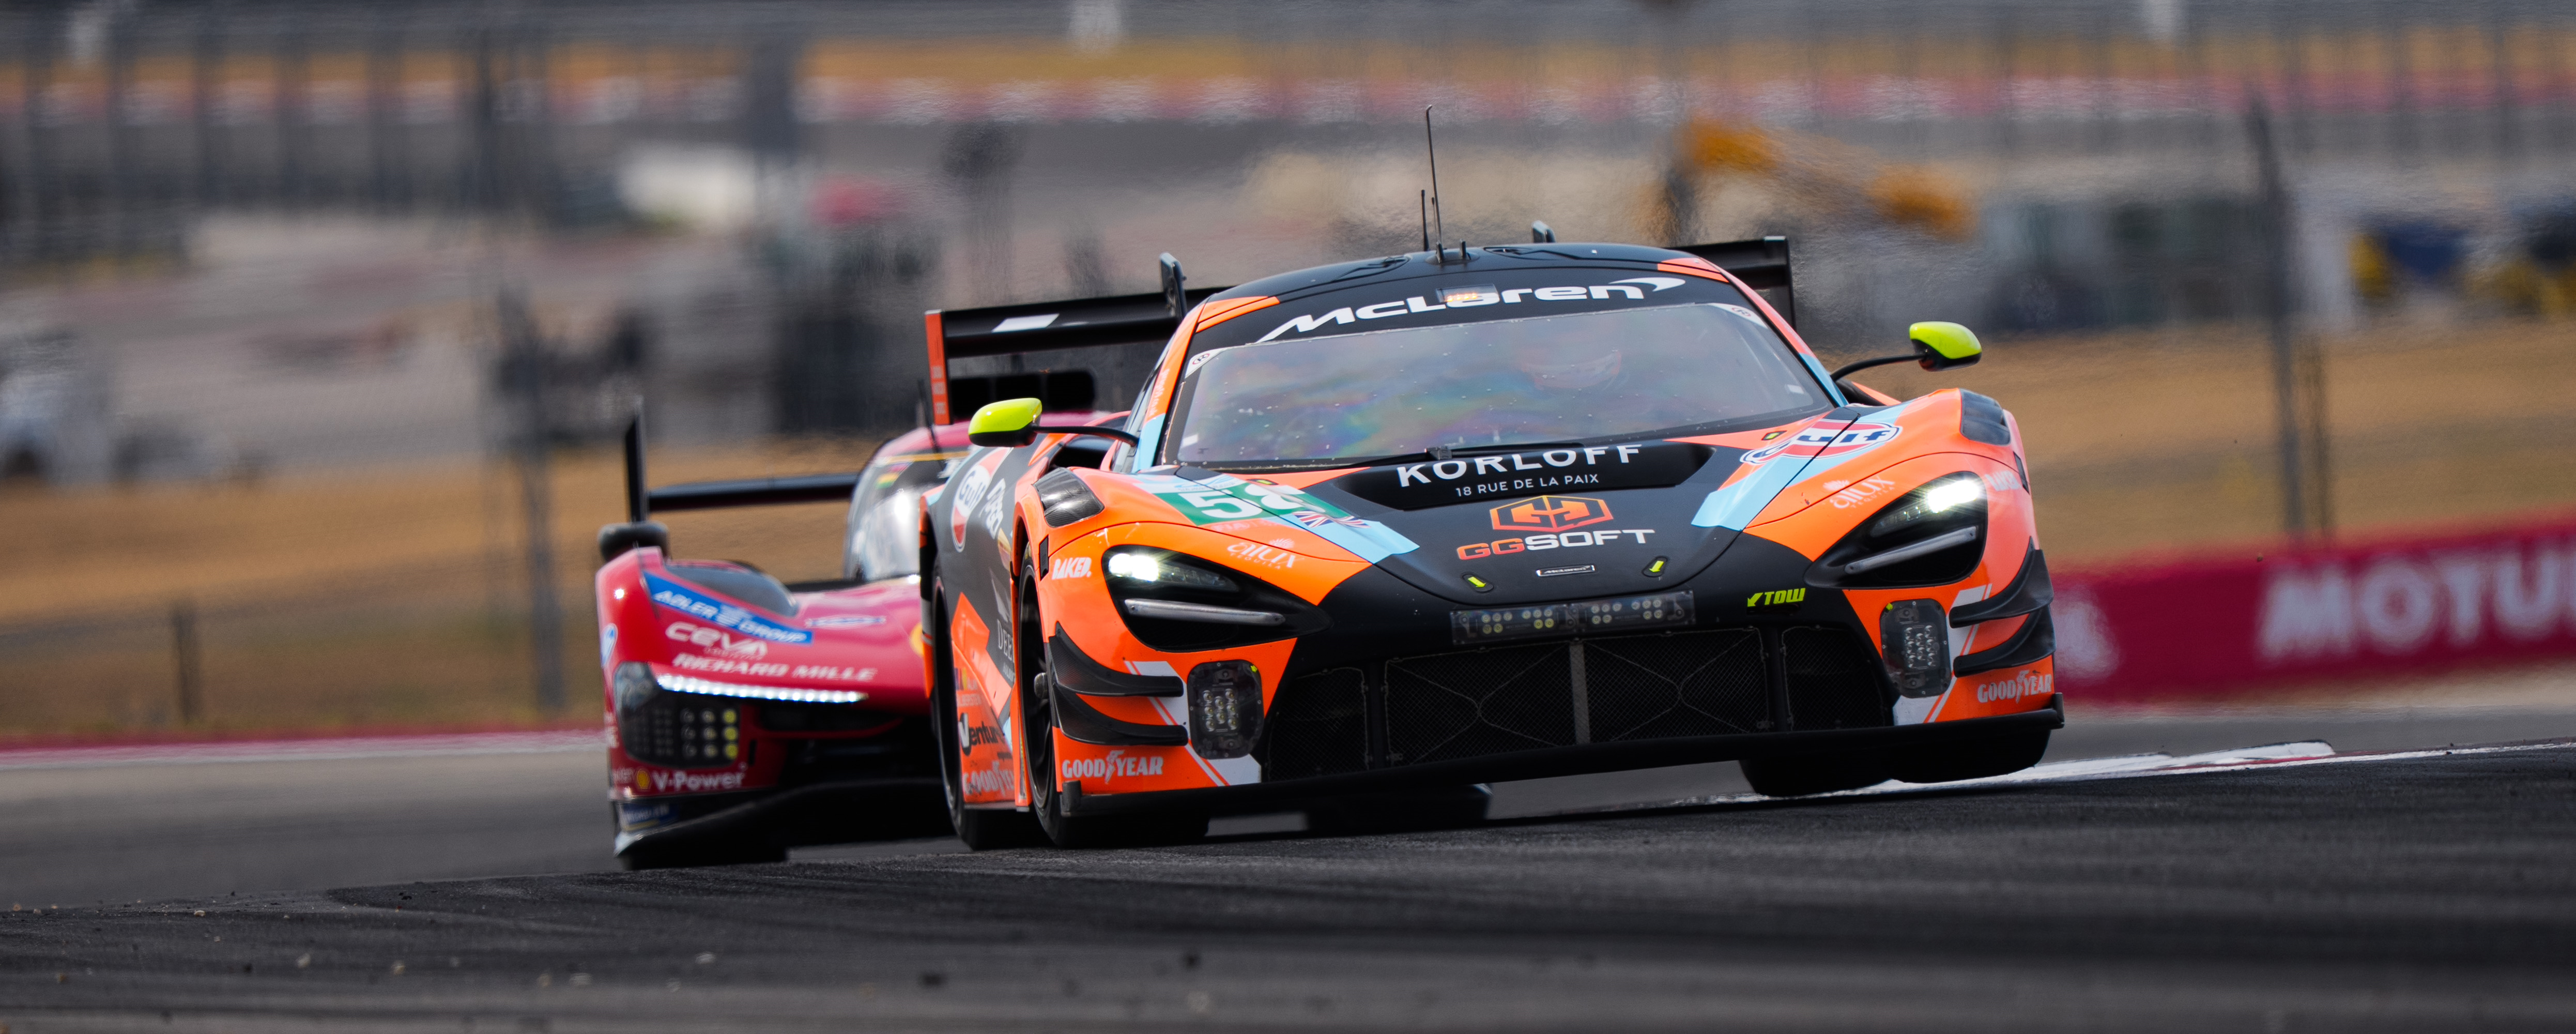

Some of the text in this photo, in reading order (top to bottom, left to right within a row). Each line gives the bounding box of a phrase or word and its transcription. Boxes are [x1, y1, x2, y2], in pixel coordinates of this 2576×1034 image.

[1255, 276, 1686, 343] McLaren
[1396, 444, 1642, 488] KORLOFF
[1455, 474, 1599, 497] 18 RUE DE LA PAIX
[1850, 486, 1895, 509] TEQUILA
[1456, 529, 1655, 560] GGSOFT
[1230, 553, 1281, 569] TEQUILA
[1764, 587, 1806, 605] TOW
[653, 590, 807, 643] ADLER GROUP
[671, 652, 790, 677] RICHARD
[792, 664, 878, 682] MILLE
[1977, 673, 2052, 703] GOODYEAR
[651, 769, 745, 792] V-Power
[1062, 754, 1163, 780] GOODYEAR
